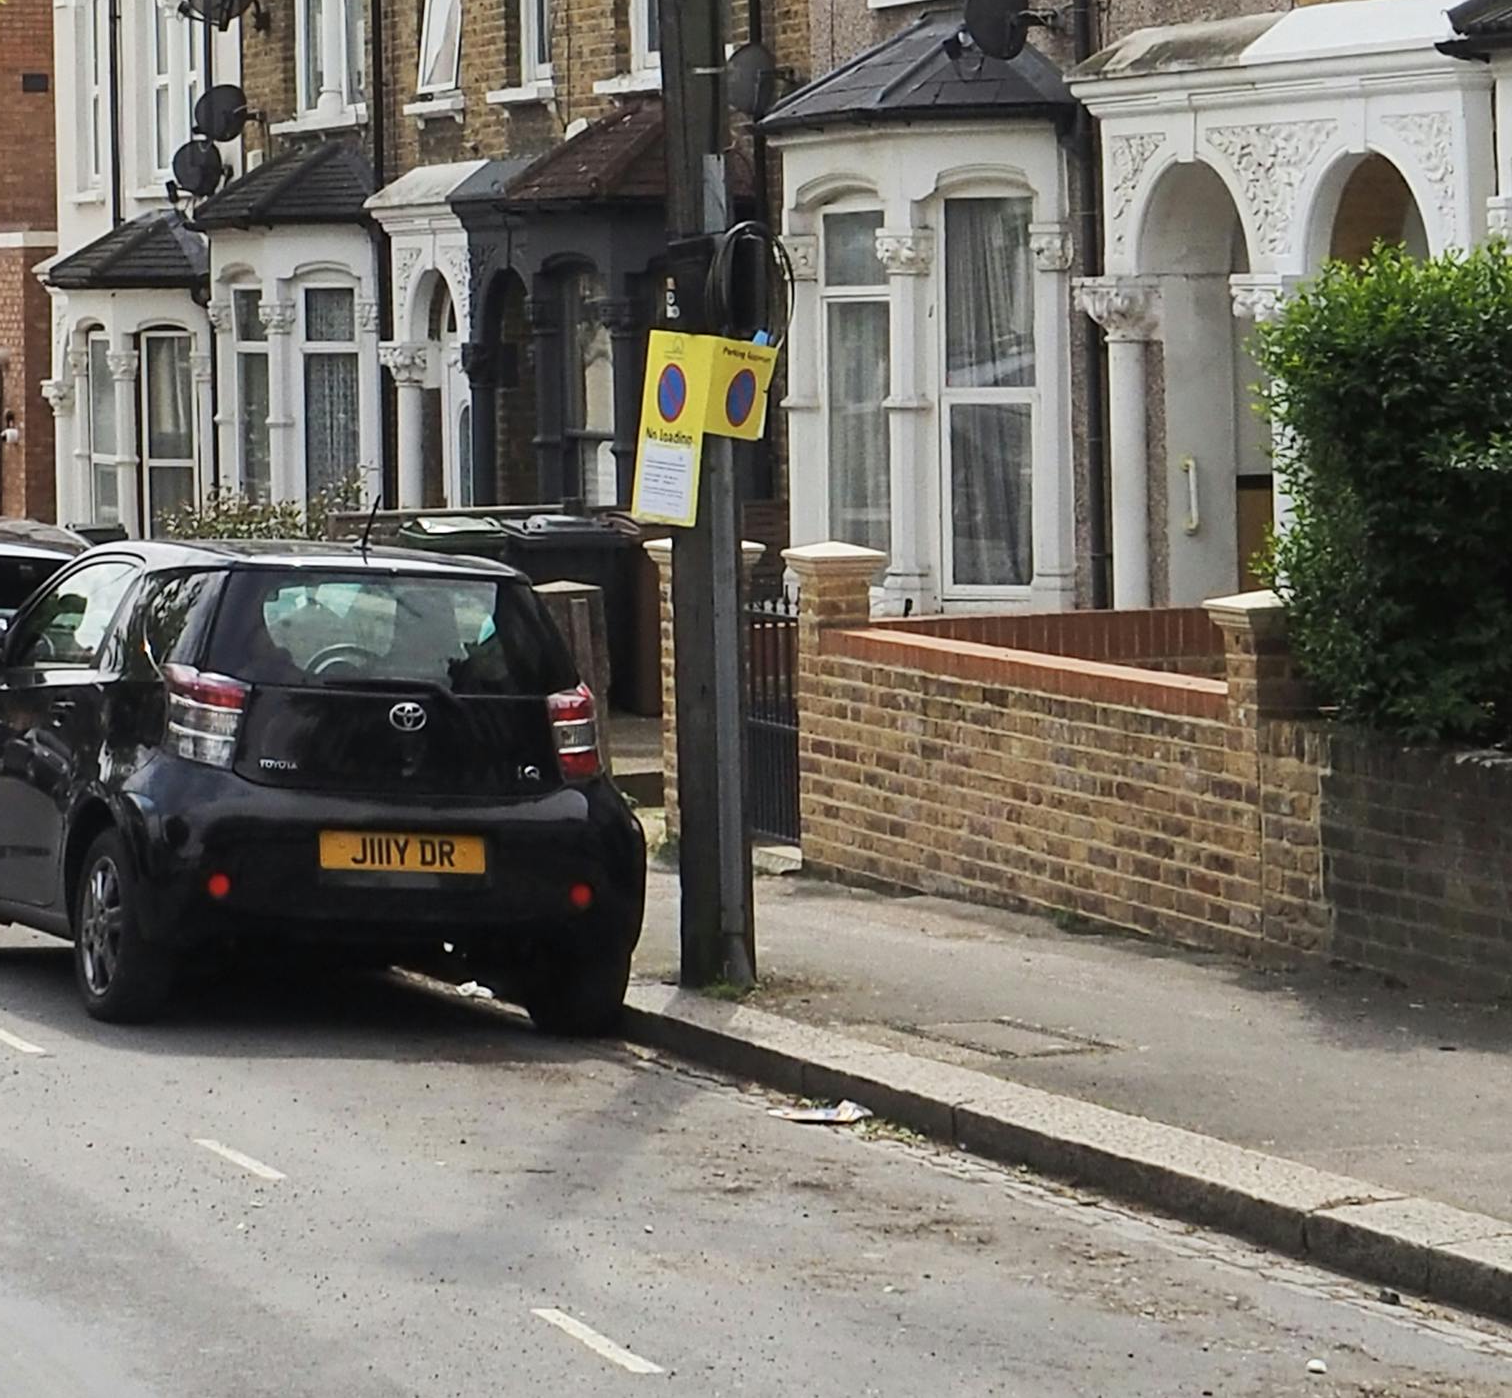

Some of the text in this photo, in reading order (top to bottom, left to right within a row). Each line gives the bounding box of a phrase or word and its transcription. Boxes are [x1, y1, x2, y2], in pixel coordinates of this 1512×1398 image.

[646, 426, 693, 448] No loading
[259, 758, 298, 770] TOYOTA
[419, 838, 456, 869] DR
